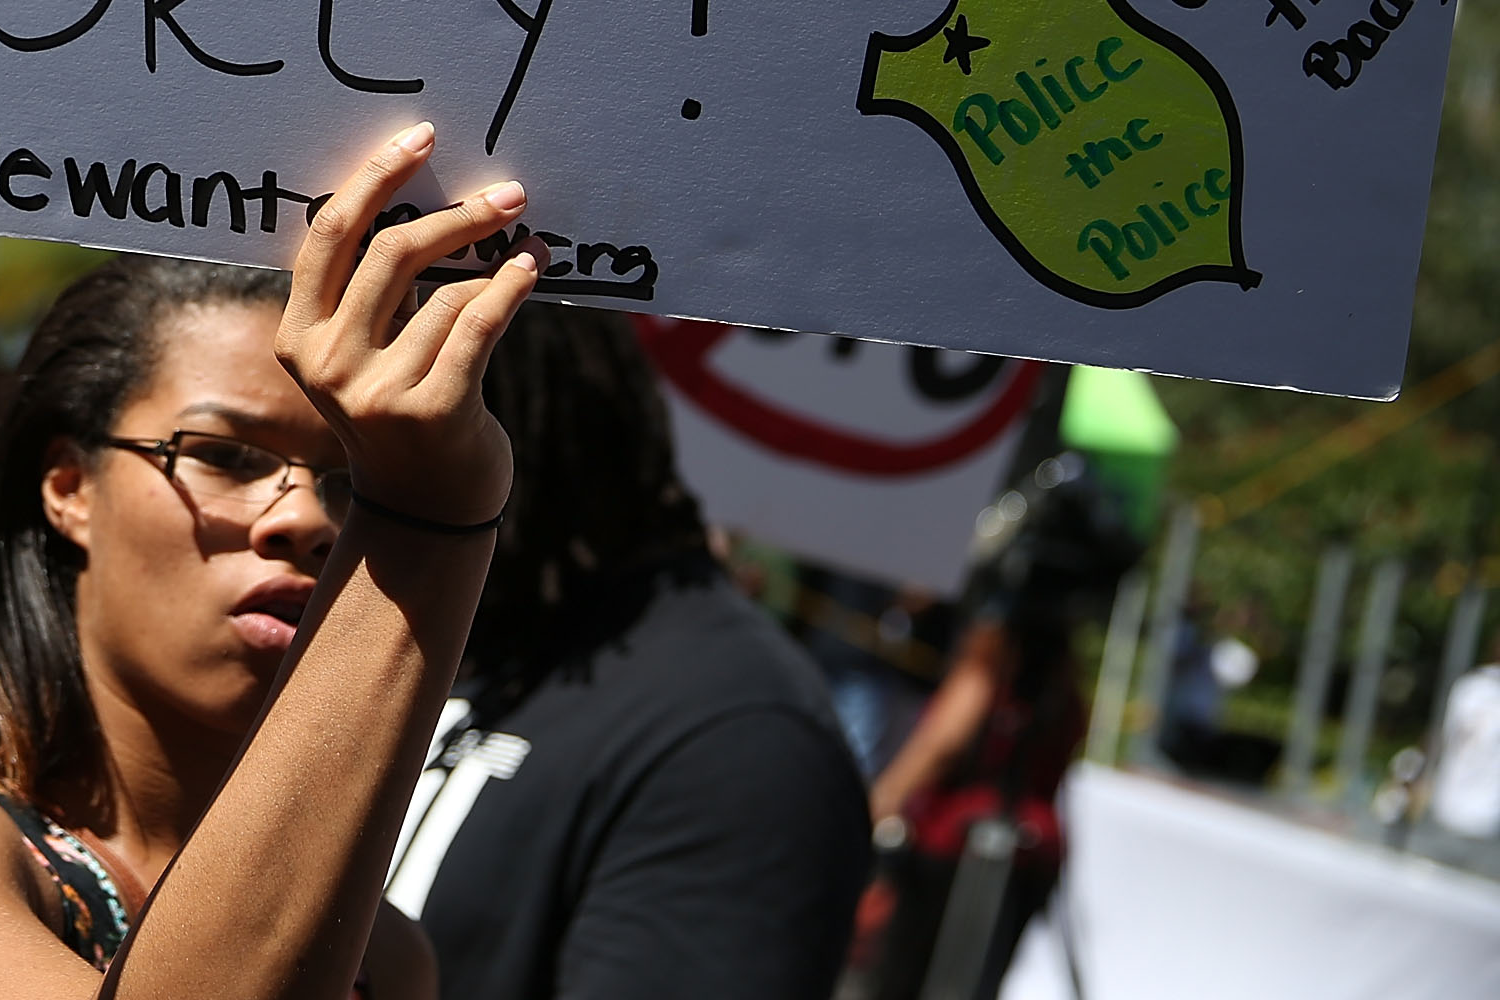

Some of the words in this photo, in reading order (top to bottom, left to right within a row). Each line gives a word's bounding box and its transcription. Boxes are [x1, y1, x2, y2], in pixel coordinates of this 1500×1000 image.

[952, 37, 1143, 166] Police
[1064, 117, 1164, 190] the
[1076, 167, 1232, 282] Police
